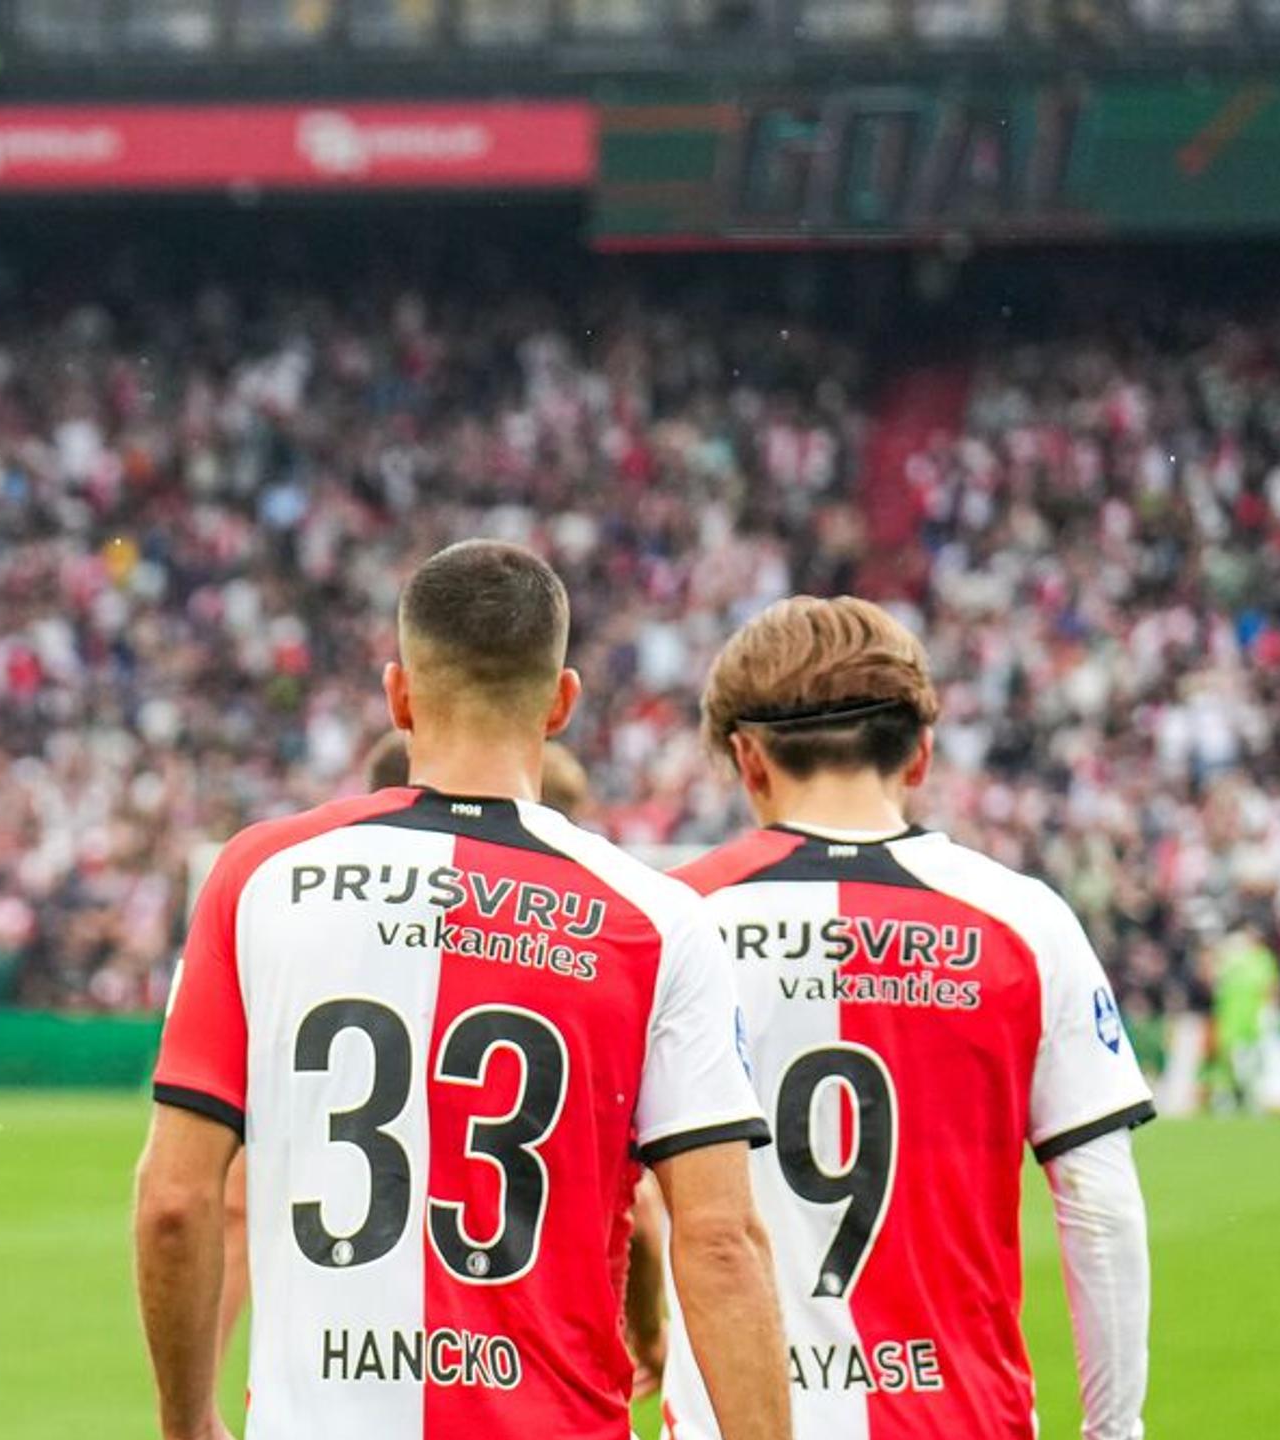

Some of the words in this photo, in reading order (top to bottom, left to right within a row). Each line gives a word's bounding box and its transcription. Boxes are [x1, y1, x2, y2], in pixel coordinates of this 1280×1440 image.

[377, 916, 597, 980] vakanties
[719, 918, 981, 969] RIJSVRIJ
[779, 969, 981, 1008] vakanties
[291, 997, 568, 1285] 33
[777, 1042, 895, 1298] 9
[322, 1329, 520, 1389] HANCKO
[789, 1341, 943, 1392] AYASE
